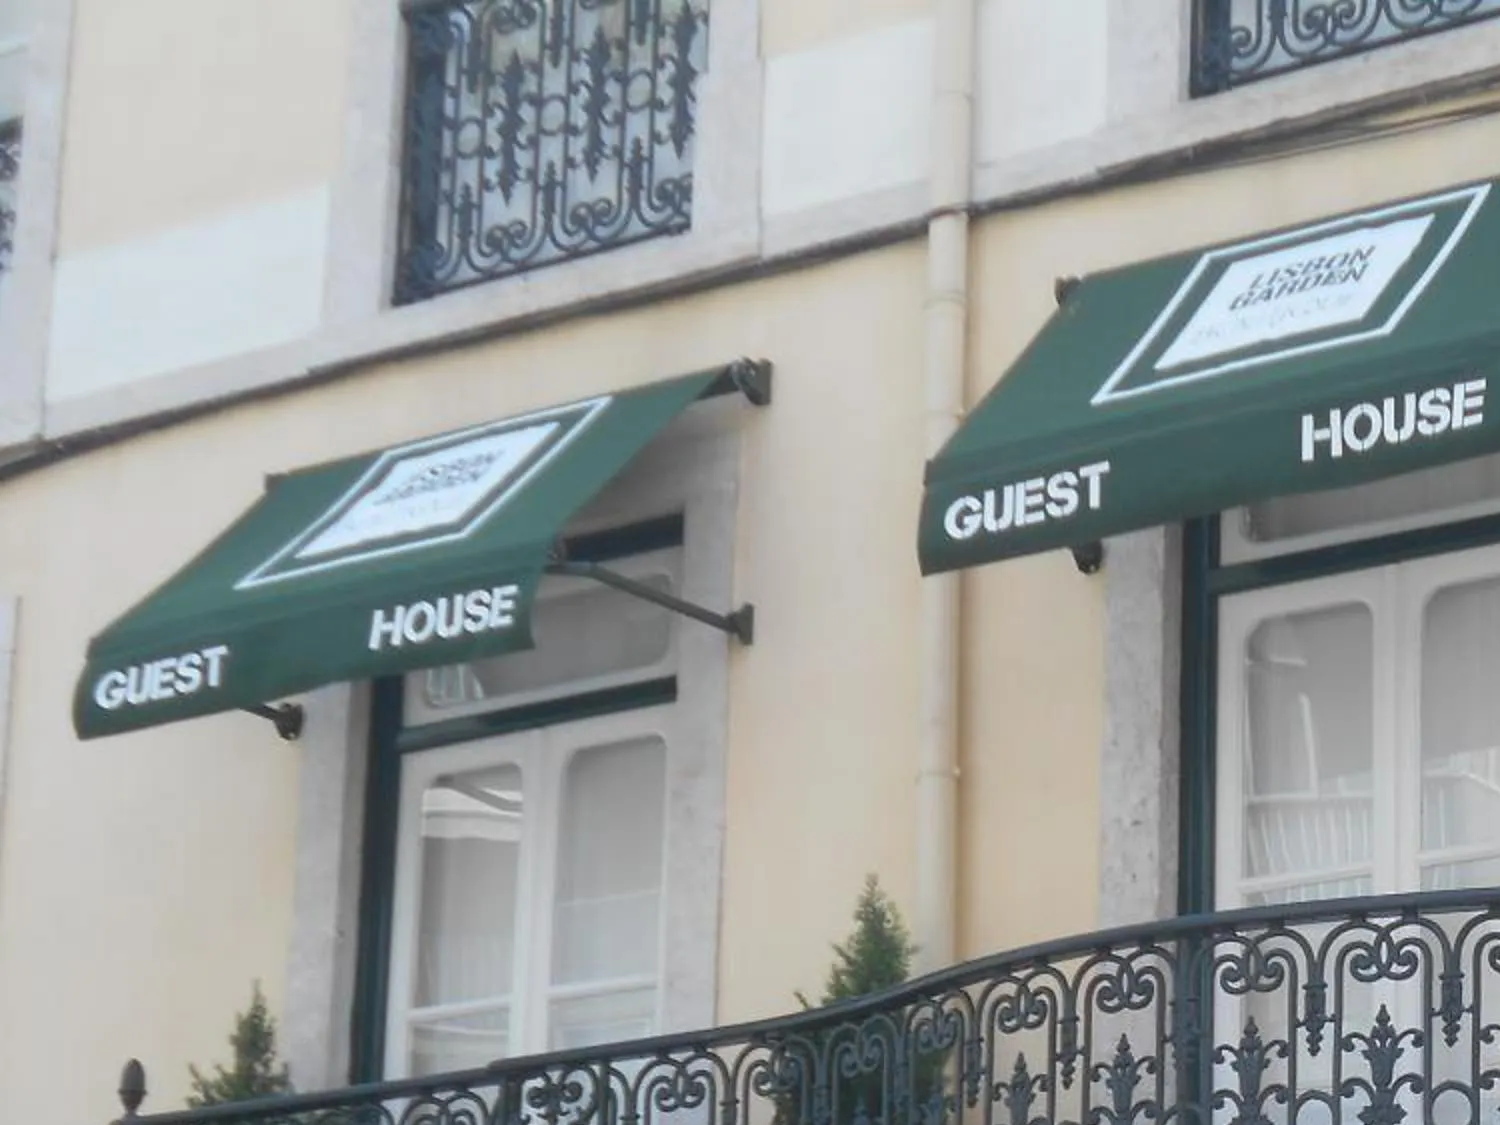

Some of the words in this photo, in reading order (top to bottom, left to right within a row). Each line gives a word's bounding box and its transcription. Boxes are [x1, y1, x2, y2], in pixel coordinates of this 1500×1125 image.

[1228, 262, 1369, 311] GARDEN
[1249, 245, 1377, 289] LISBON
[943, 460, 1110, 541] GUEST
[1301, 378, 1487, 462] HOUSE
[95, 646, 231, 711] GUEST
[367, 584, 519, 650] HOUSE
